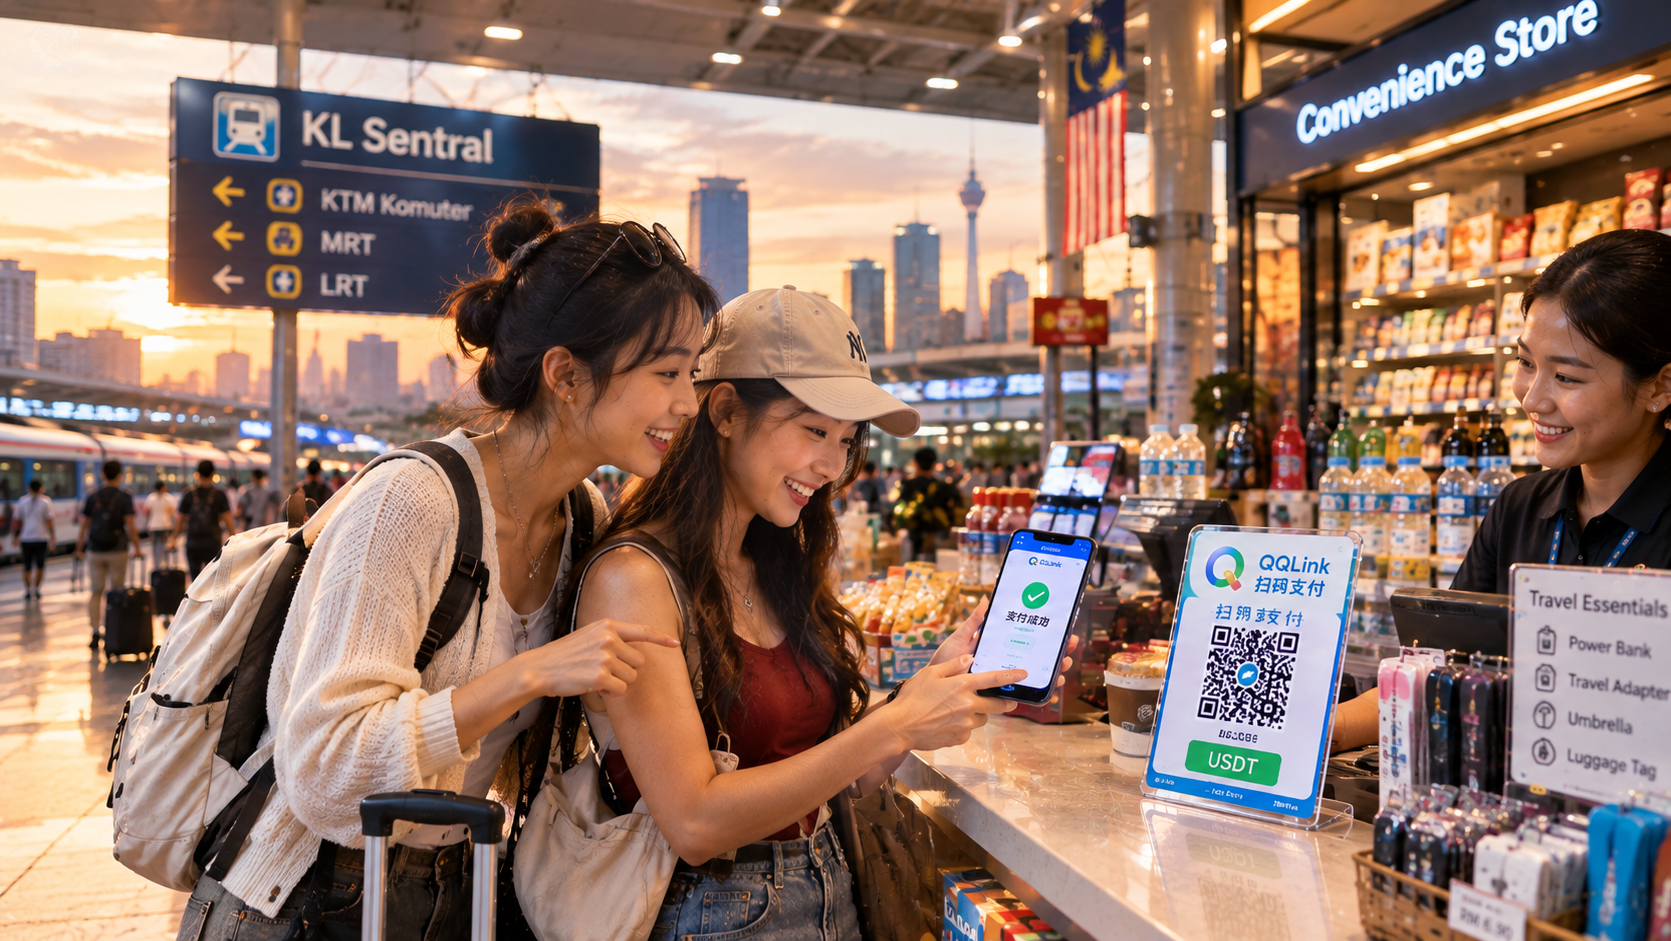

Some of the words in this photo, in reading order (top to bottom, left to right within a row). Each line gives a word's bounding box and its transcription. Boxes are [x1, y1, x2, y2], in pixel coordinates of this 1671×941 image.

[1296, 44, 1486, 145] Convenience
[1494, 0, 1599, 68] Store
[302, 109, 353, 151] KL
[362, 117, 495, 164] Sentral
[321, 188, 376, 214] KTM
[380, 193, 474, 222] Komuter
[321, 231, 376, 256] MRT
[320, 273, 369, 298] LRT
[1259, 554, 1331, 575] QQLink
[1529, 589, 1577, 610] Travel
[1582, 594, 1669, 619] Essentials
[1569, 635, 1612, 653] Power
[1616, 640, 1652, 659] Bank
[1568, 673, 1609, 692] Travel
[1612, 679, 1671, 701] Adapter
[1568, 711, 1633, 735] Umbrella
[1208, 751, 1259, 775] USDT
[1567, 748, 1627, 774] Luggage
[1631, 758, 1657, 782] Tag
